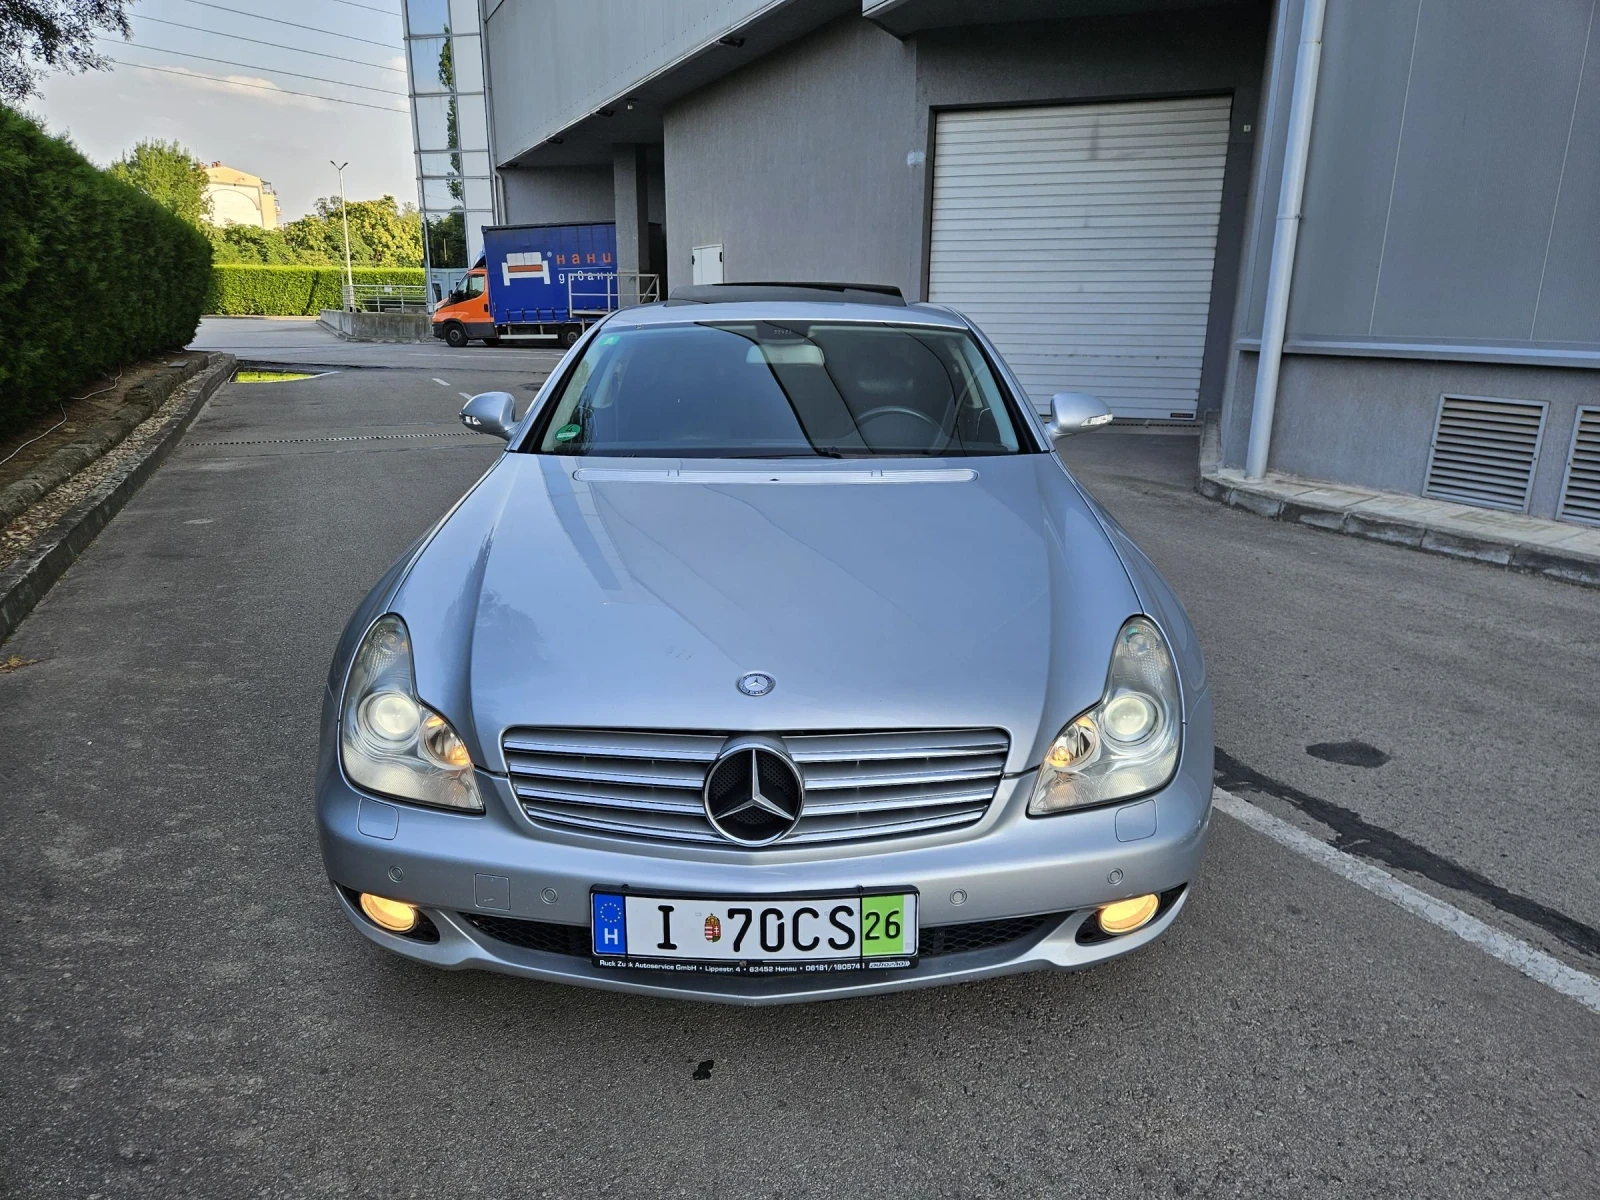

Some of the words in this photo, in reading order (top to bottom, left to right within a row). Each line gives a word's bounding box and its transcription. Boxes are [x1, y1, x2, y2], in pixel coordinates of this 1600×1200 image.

[604, 928, 619, 945] H
[727, 905, 855, 953] 70CS
[864, 910, 900, 940] 26
[599, 959, 616, 967] Ruck
[634, 962, 674, 970] Autoservice
[675, 964, 697, 972] GmbH
